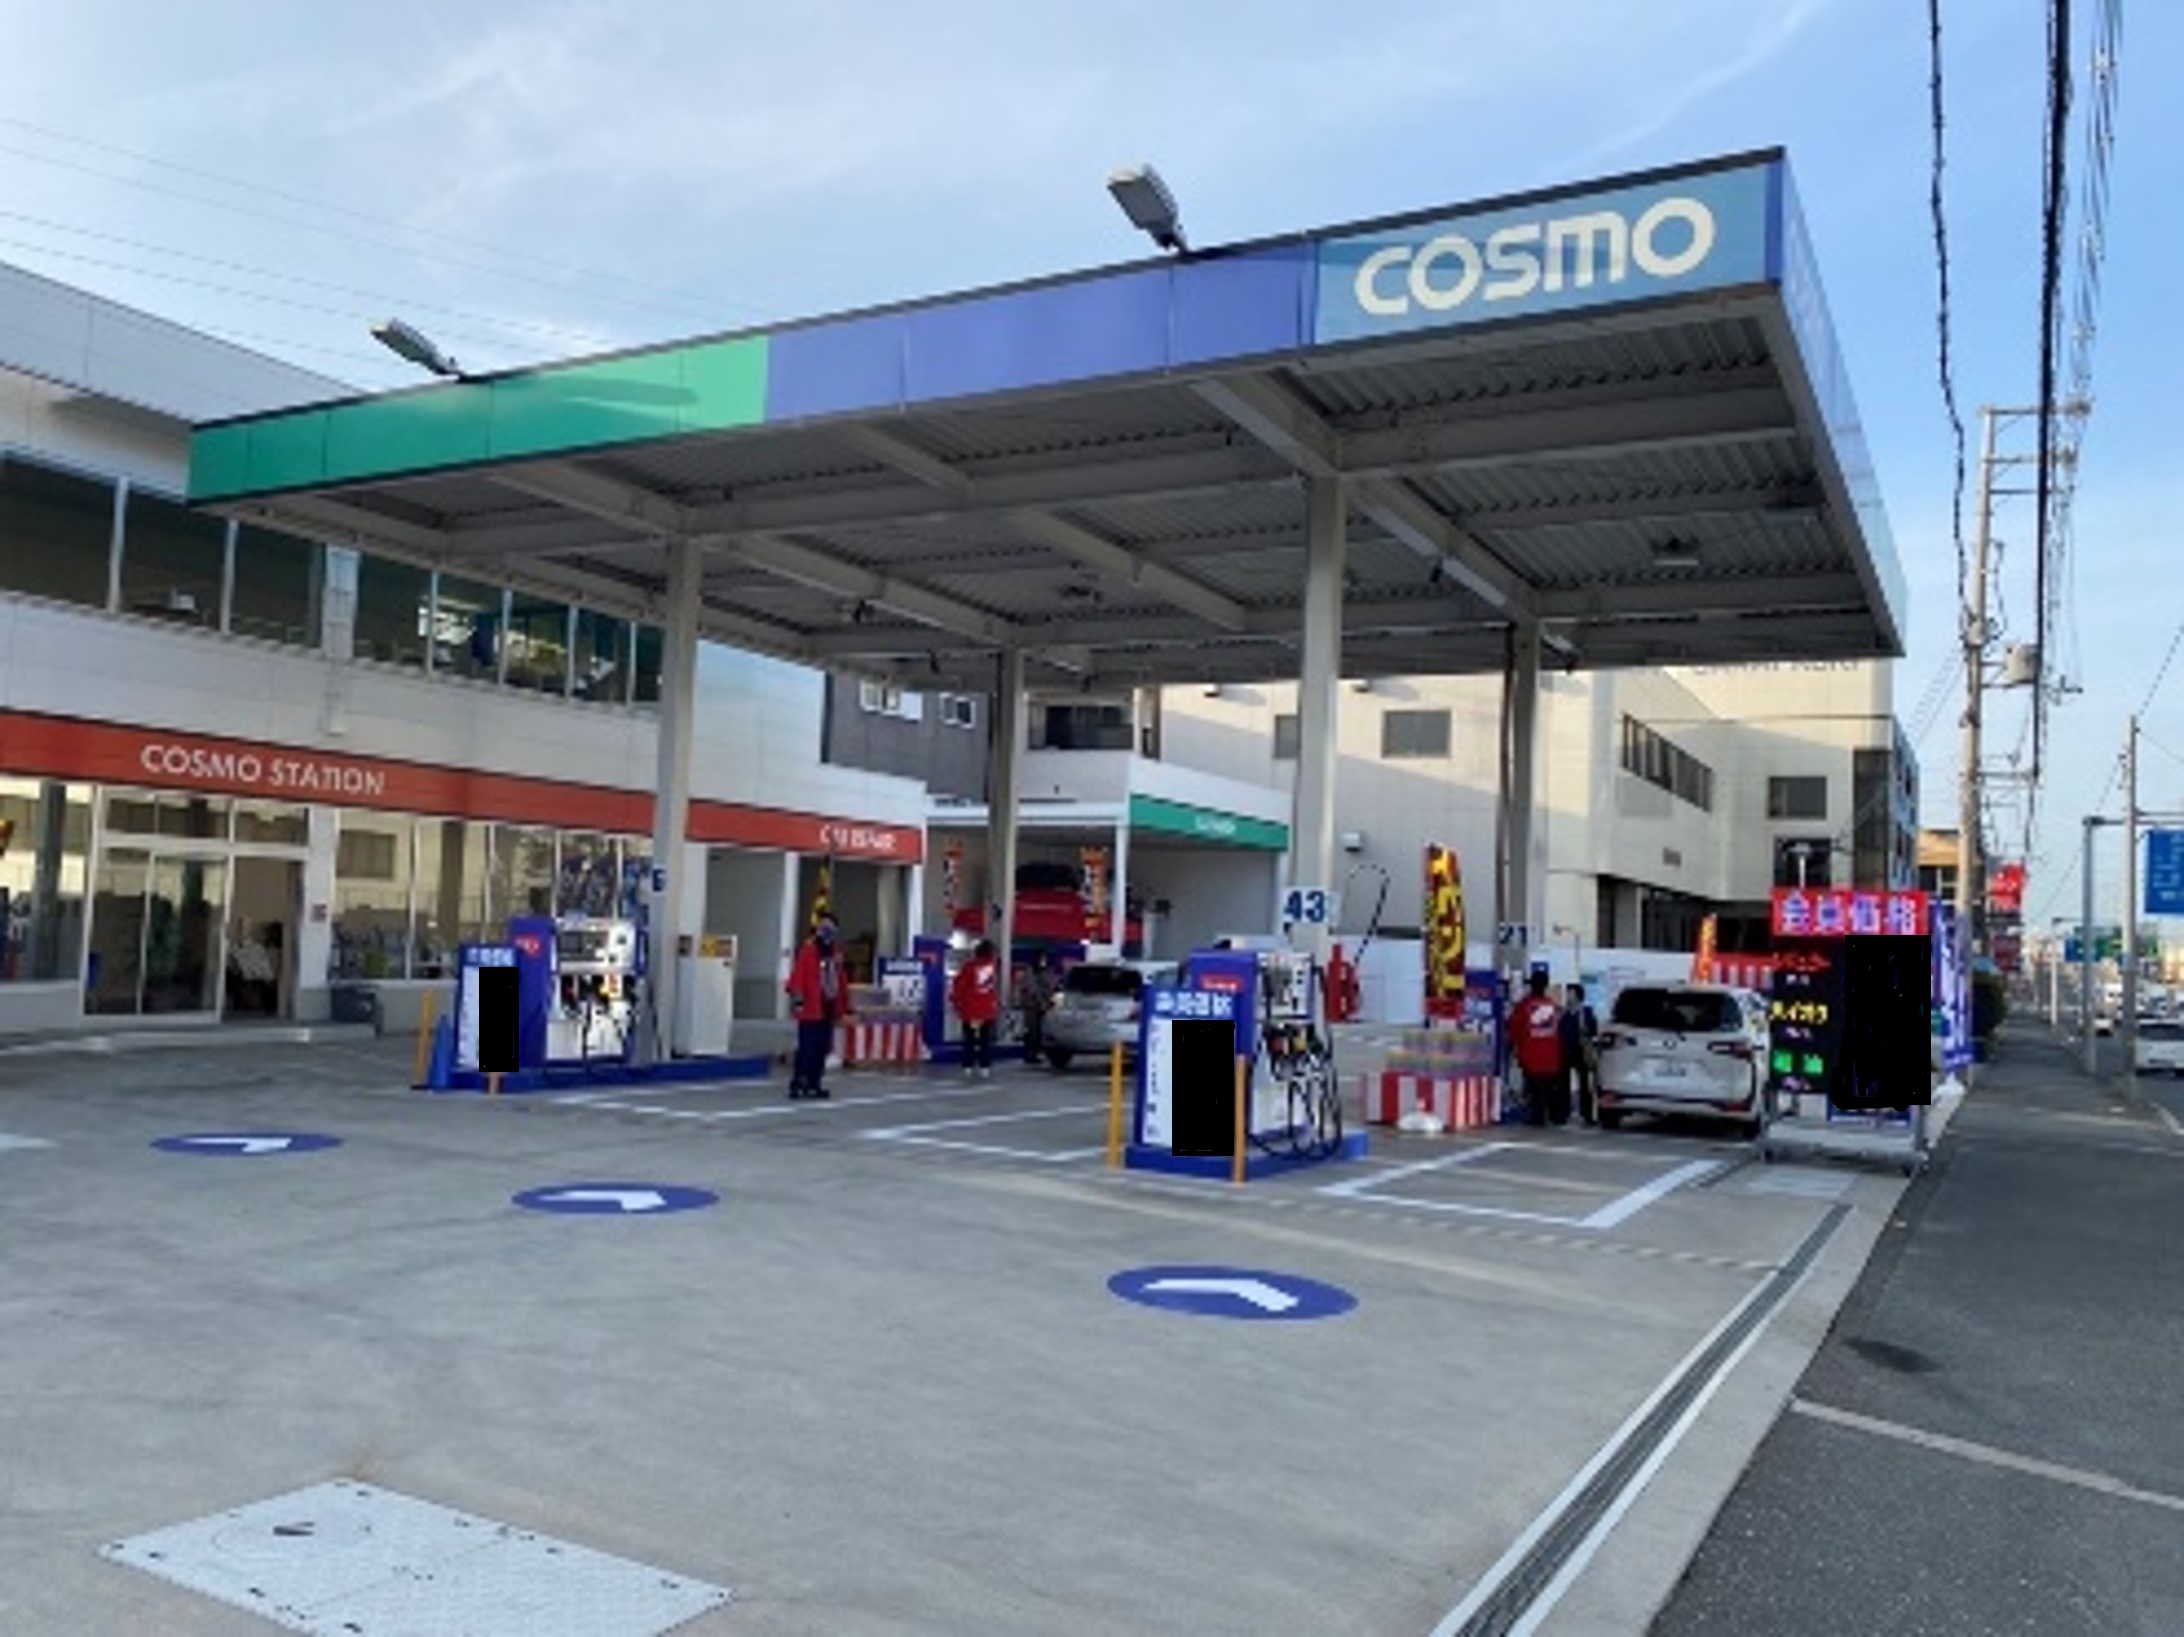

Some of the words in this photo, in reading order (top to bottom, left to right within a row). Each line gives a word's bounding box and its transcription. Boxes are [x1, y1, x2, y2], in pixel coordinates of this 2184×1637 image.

[1354, 197, 1715, 315] COSMO
[140, 744, 262, 783] COSMO
[268, 758, 386, 796] STATION
[1283, 890, 1326, 922] 43
